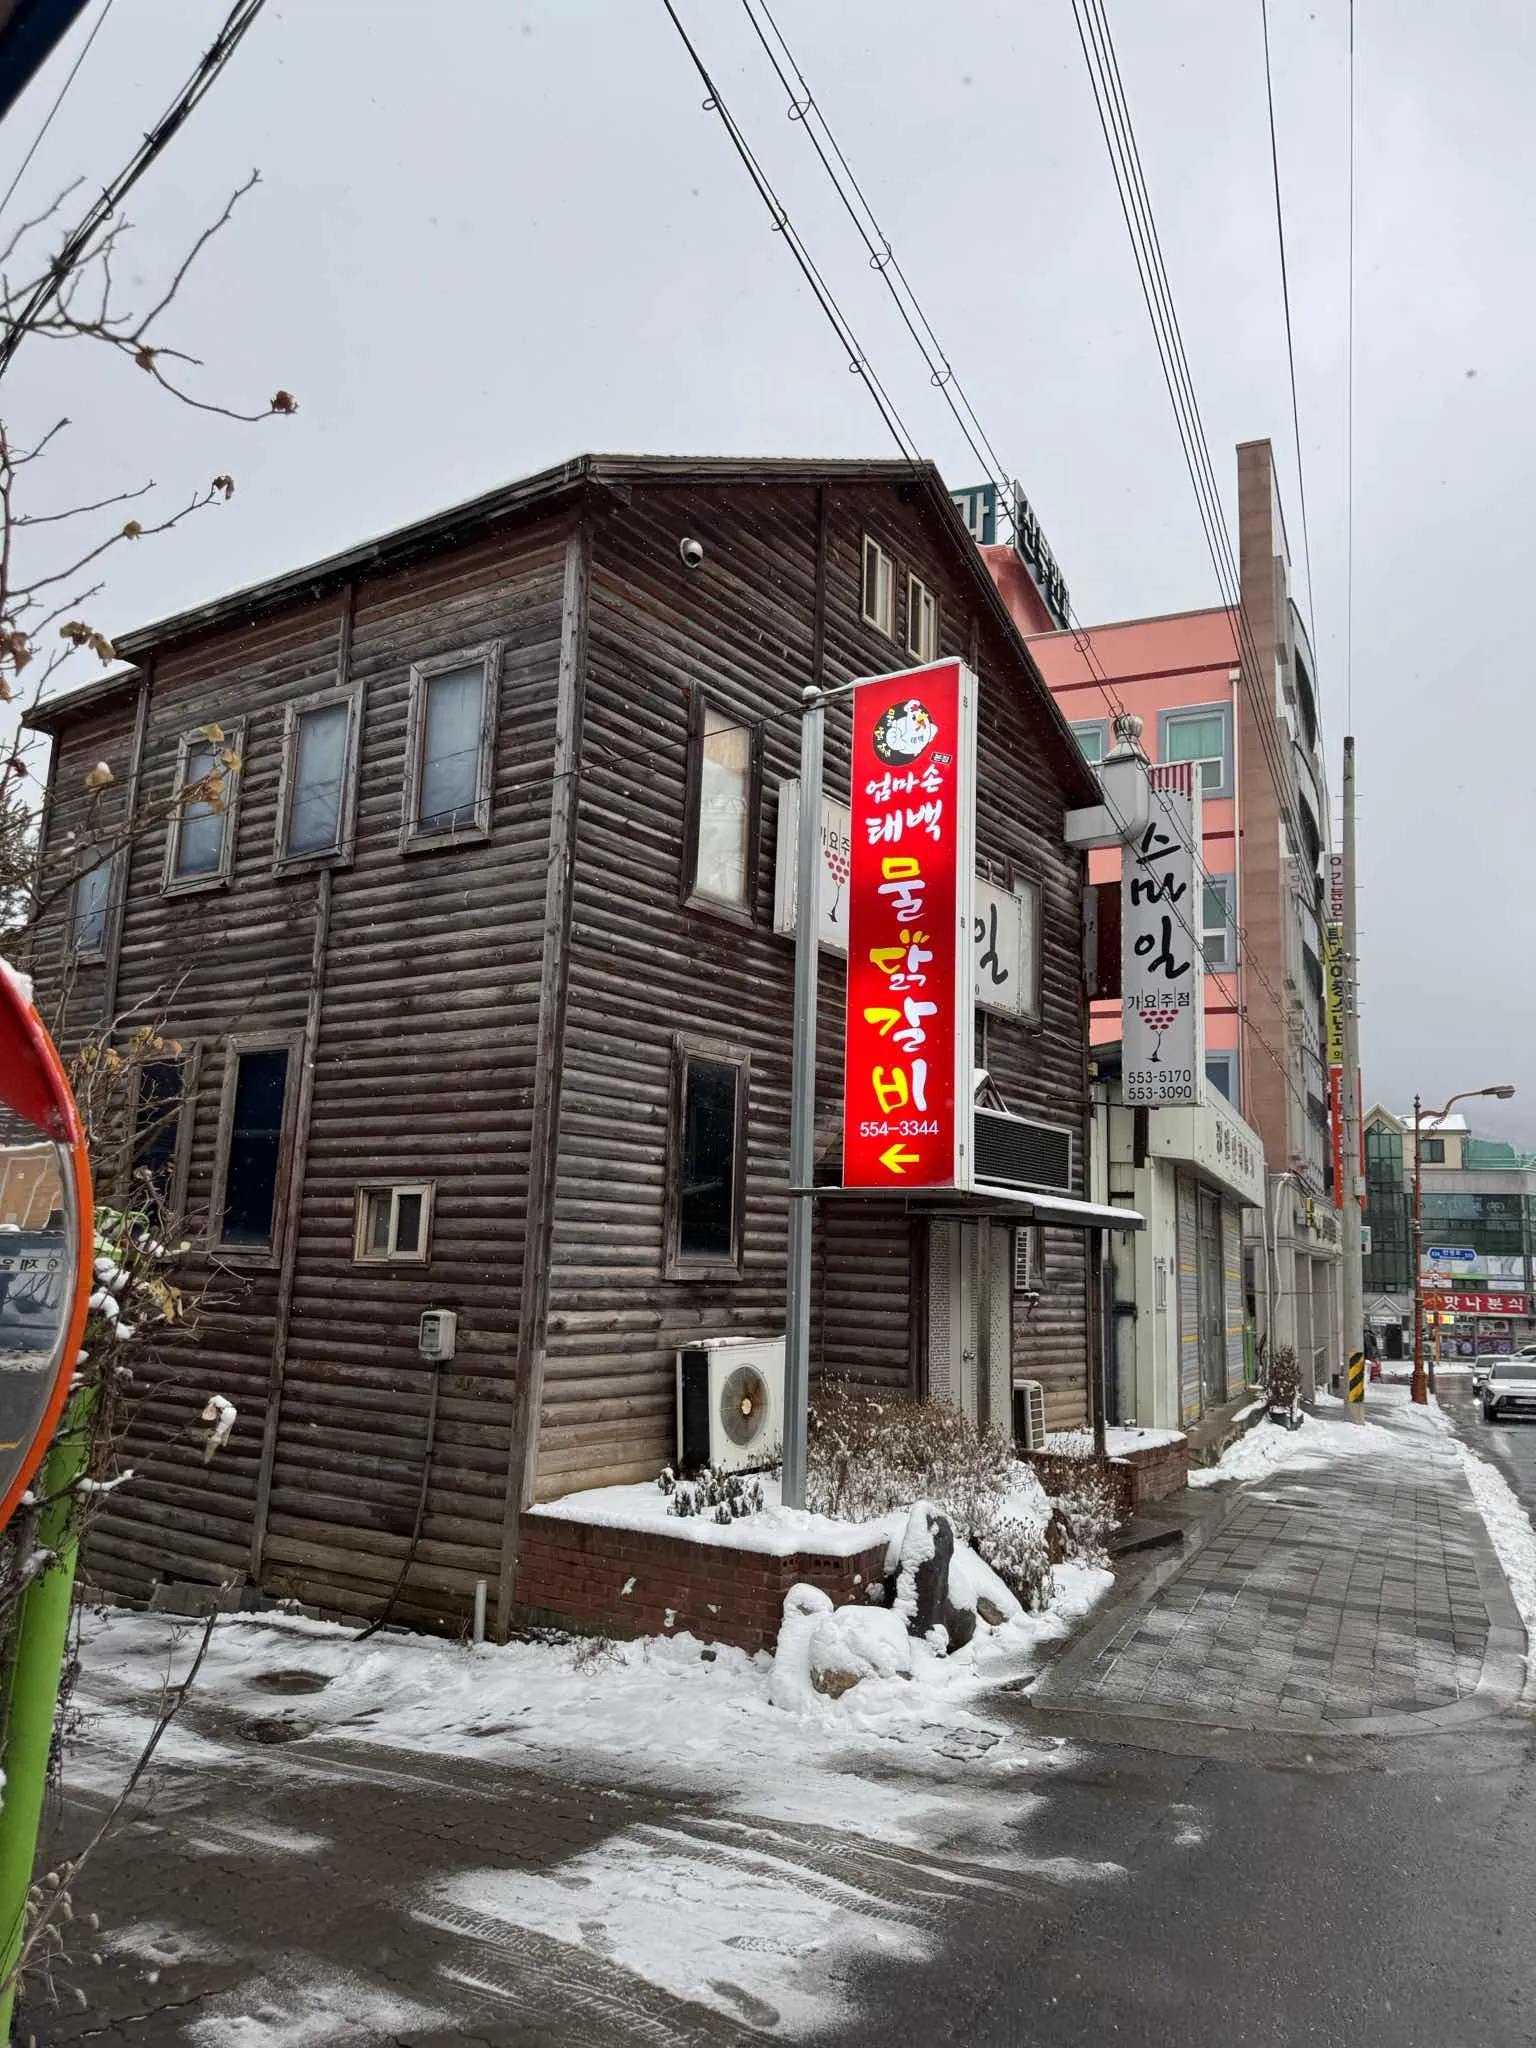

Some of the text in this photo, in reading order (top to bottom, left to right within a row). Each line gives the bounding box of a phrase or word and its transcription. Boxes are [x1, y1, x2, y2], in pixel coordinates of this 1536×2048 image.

[865, 800, 942, 845] 태백
[1130, 821, 1191, 980] 스마일
[864, 857, 938, 1113] 물닭갈비
[1127, 990, 1191, 1010] 가요주점
[1128, 1069, 1192, 1084] 553-5170
[1128, 1085, 1192, 1100] 553-3090
[860, 1120, 939, 1137] 554-3344
[1443, 1294, 1525, 1312] 맛나분식
